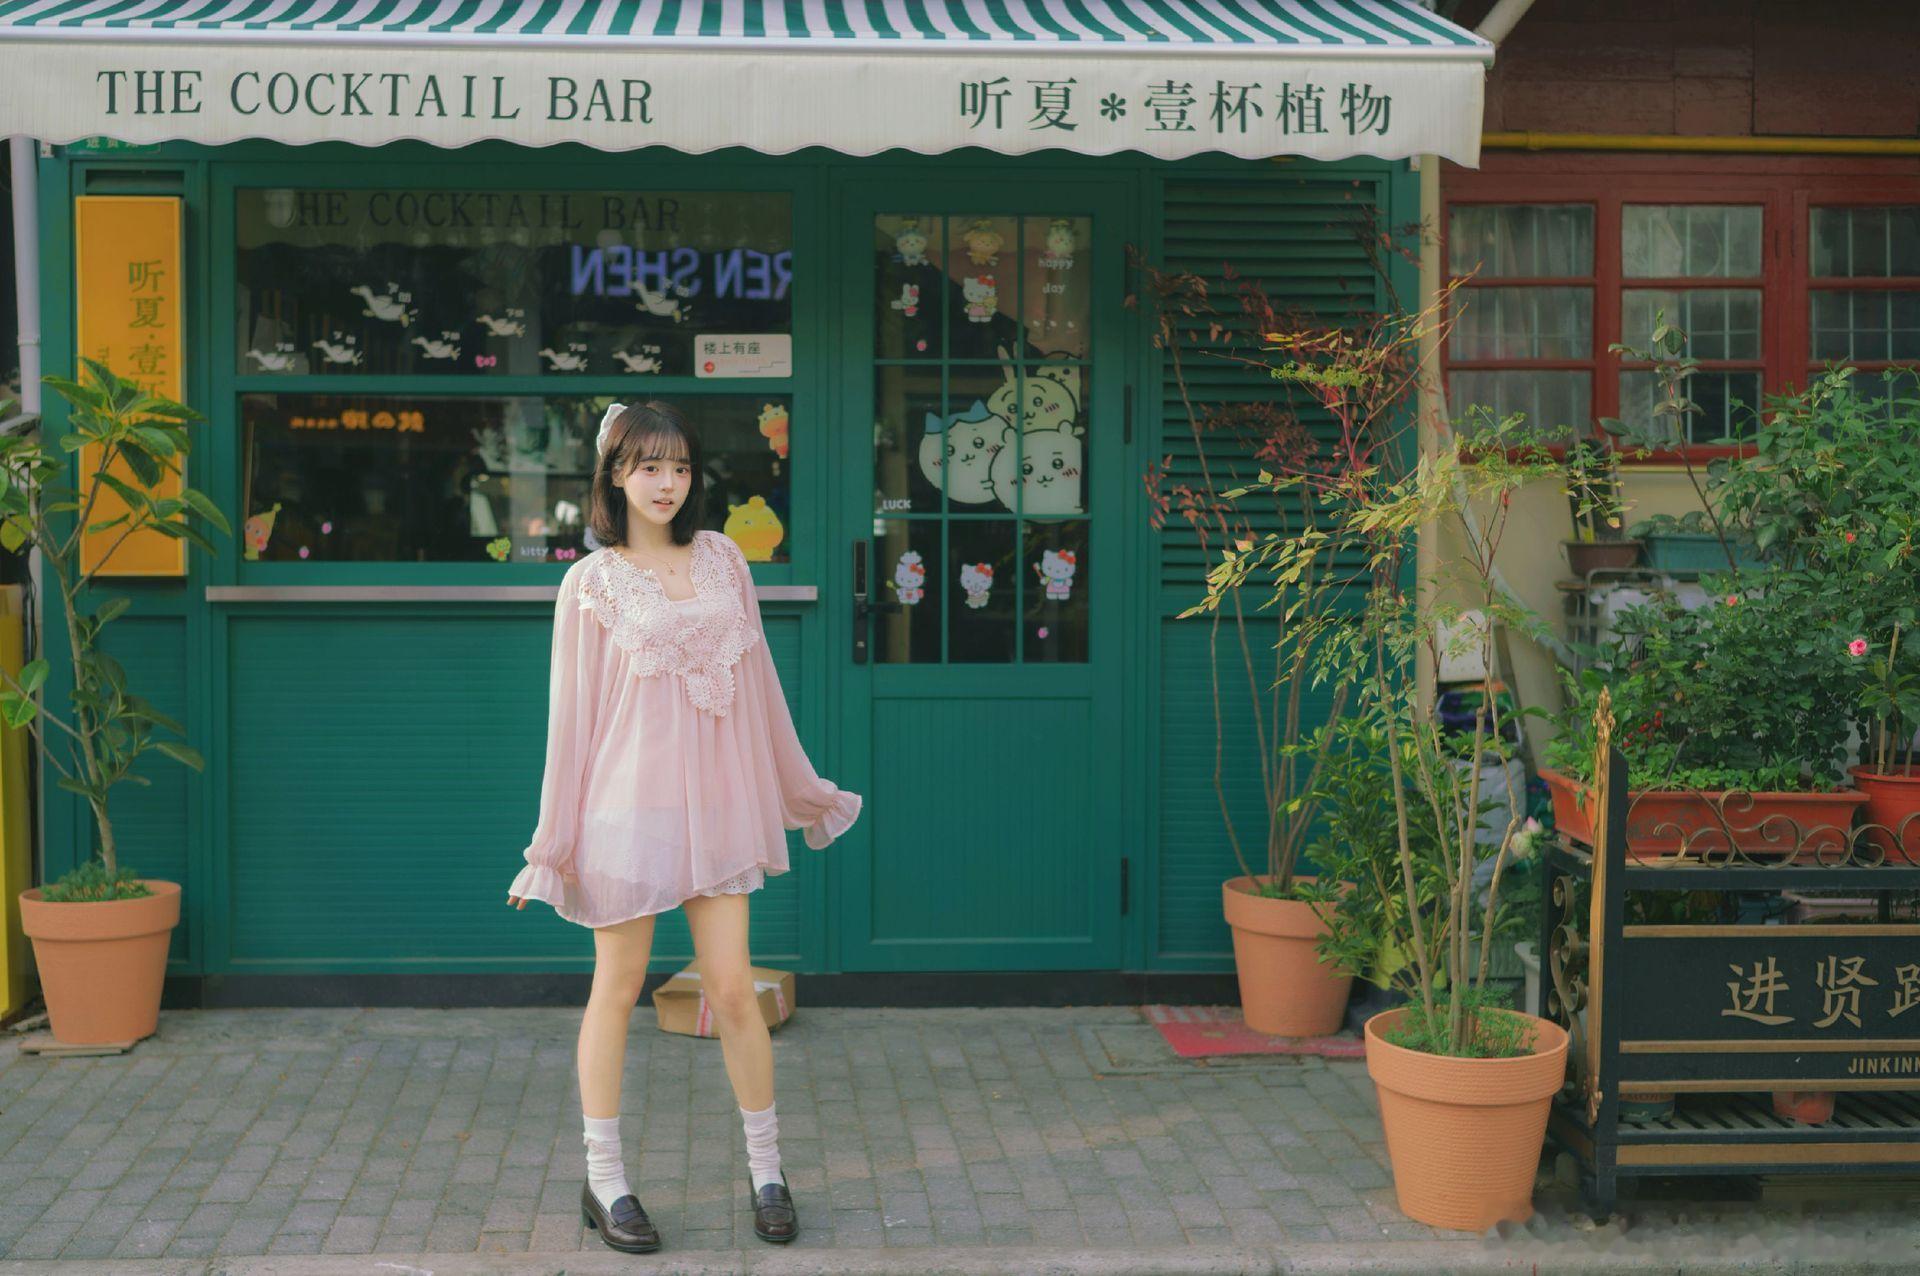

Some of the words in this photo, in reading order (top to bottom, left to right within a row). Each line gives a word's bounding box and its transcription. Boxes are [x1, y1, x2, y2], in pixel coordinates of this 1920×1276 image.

[97, 70, 202, 115] THE
[230, 71, 521, 120] COCKTAIL
[546, 76, 654, 124] BAR
[368, 191, 583, 230] COCKTAIL
[601, 195, 681, 233] BAR
[704, 341, 761, 355] 楼上有座
[882, 499, 912, 510] LUCK
[520, 545, 549, 558] kitty
